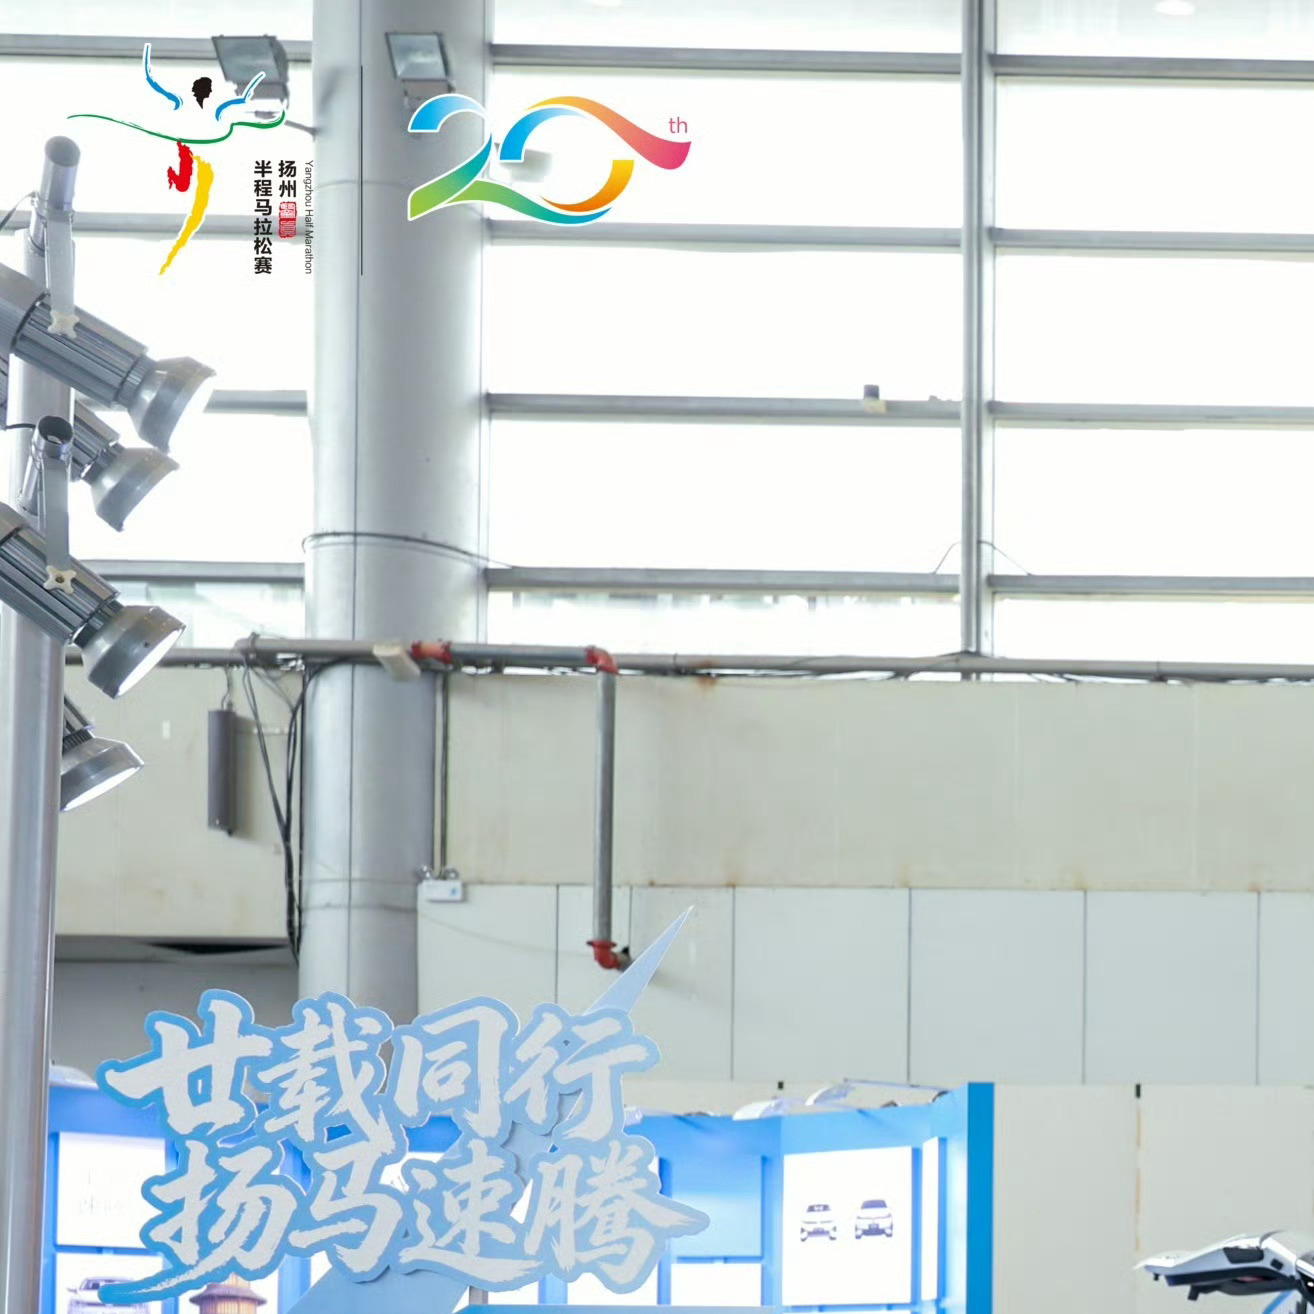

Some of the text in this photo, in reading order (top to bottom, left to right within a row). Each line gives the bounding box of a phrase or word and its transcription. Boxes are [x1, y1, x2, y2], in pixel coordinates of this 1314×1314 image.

[105, 999, 649, 1158] 廿载同行
[118, 1140, 695, 1292] 扬马速腾
